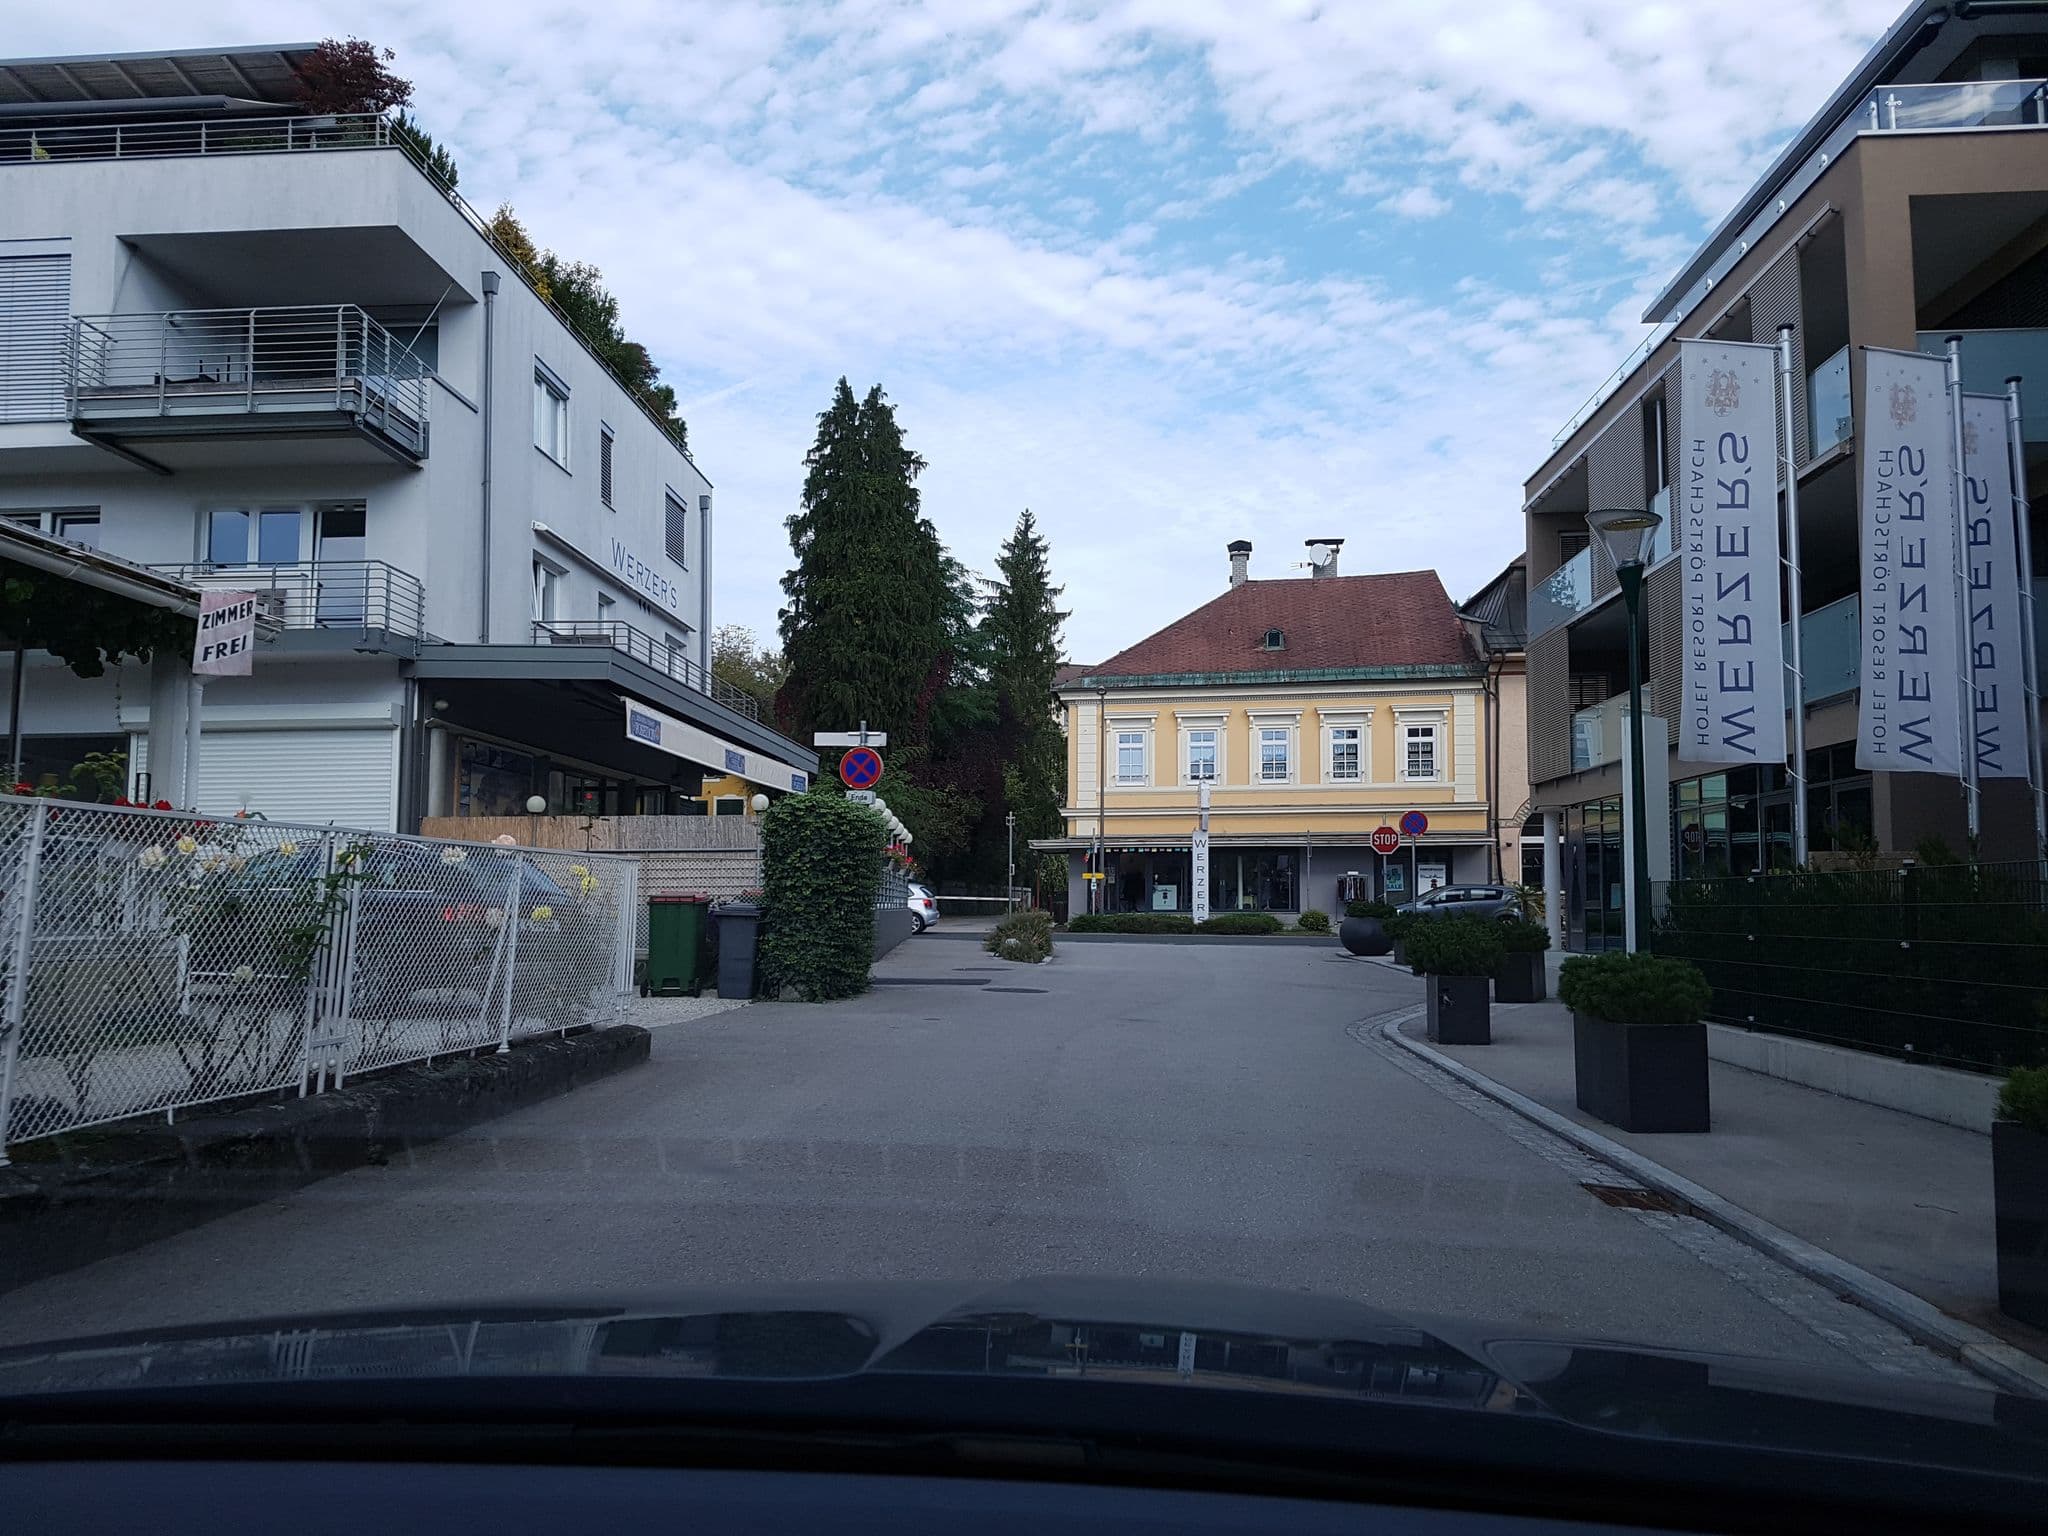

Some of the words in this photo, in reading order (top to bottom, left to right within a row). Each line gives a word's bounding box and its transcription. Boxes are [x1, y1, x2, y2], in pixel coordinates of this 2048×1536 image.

[611, 537, 677, 609] WERZER'S
[202, 600, 253, 630] ZIMMER
[202, 635, 247, 662] FREI
[1373, 833, 1397, 845] STOP
